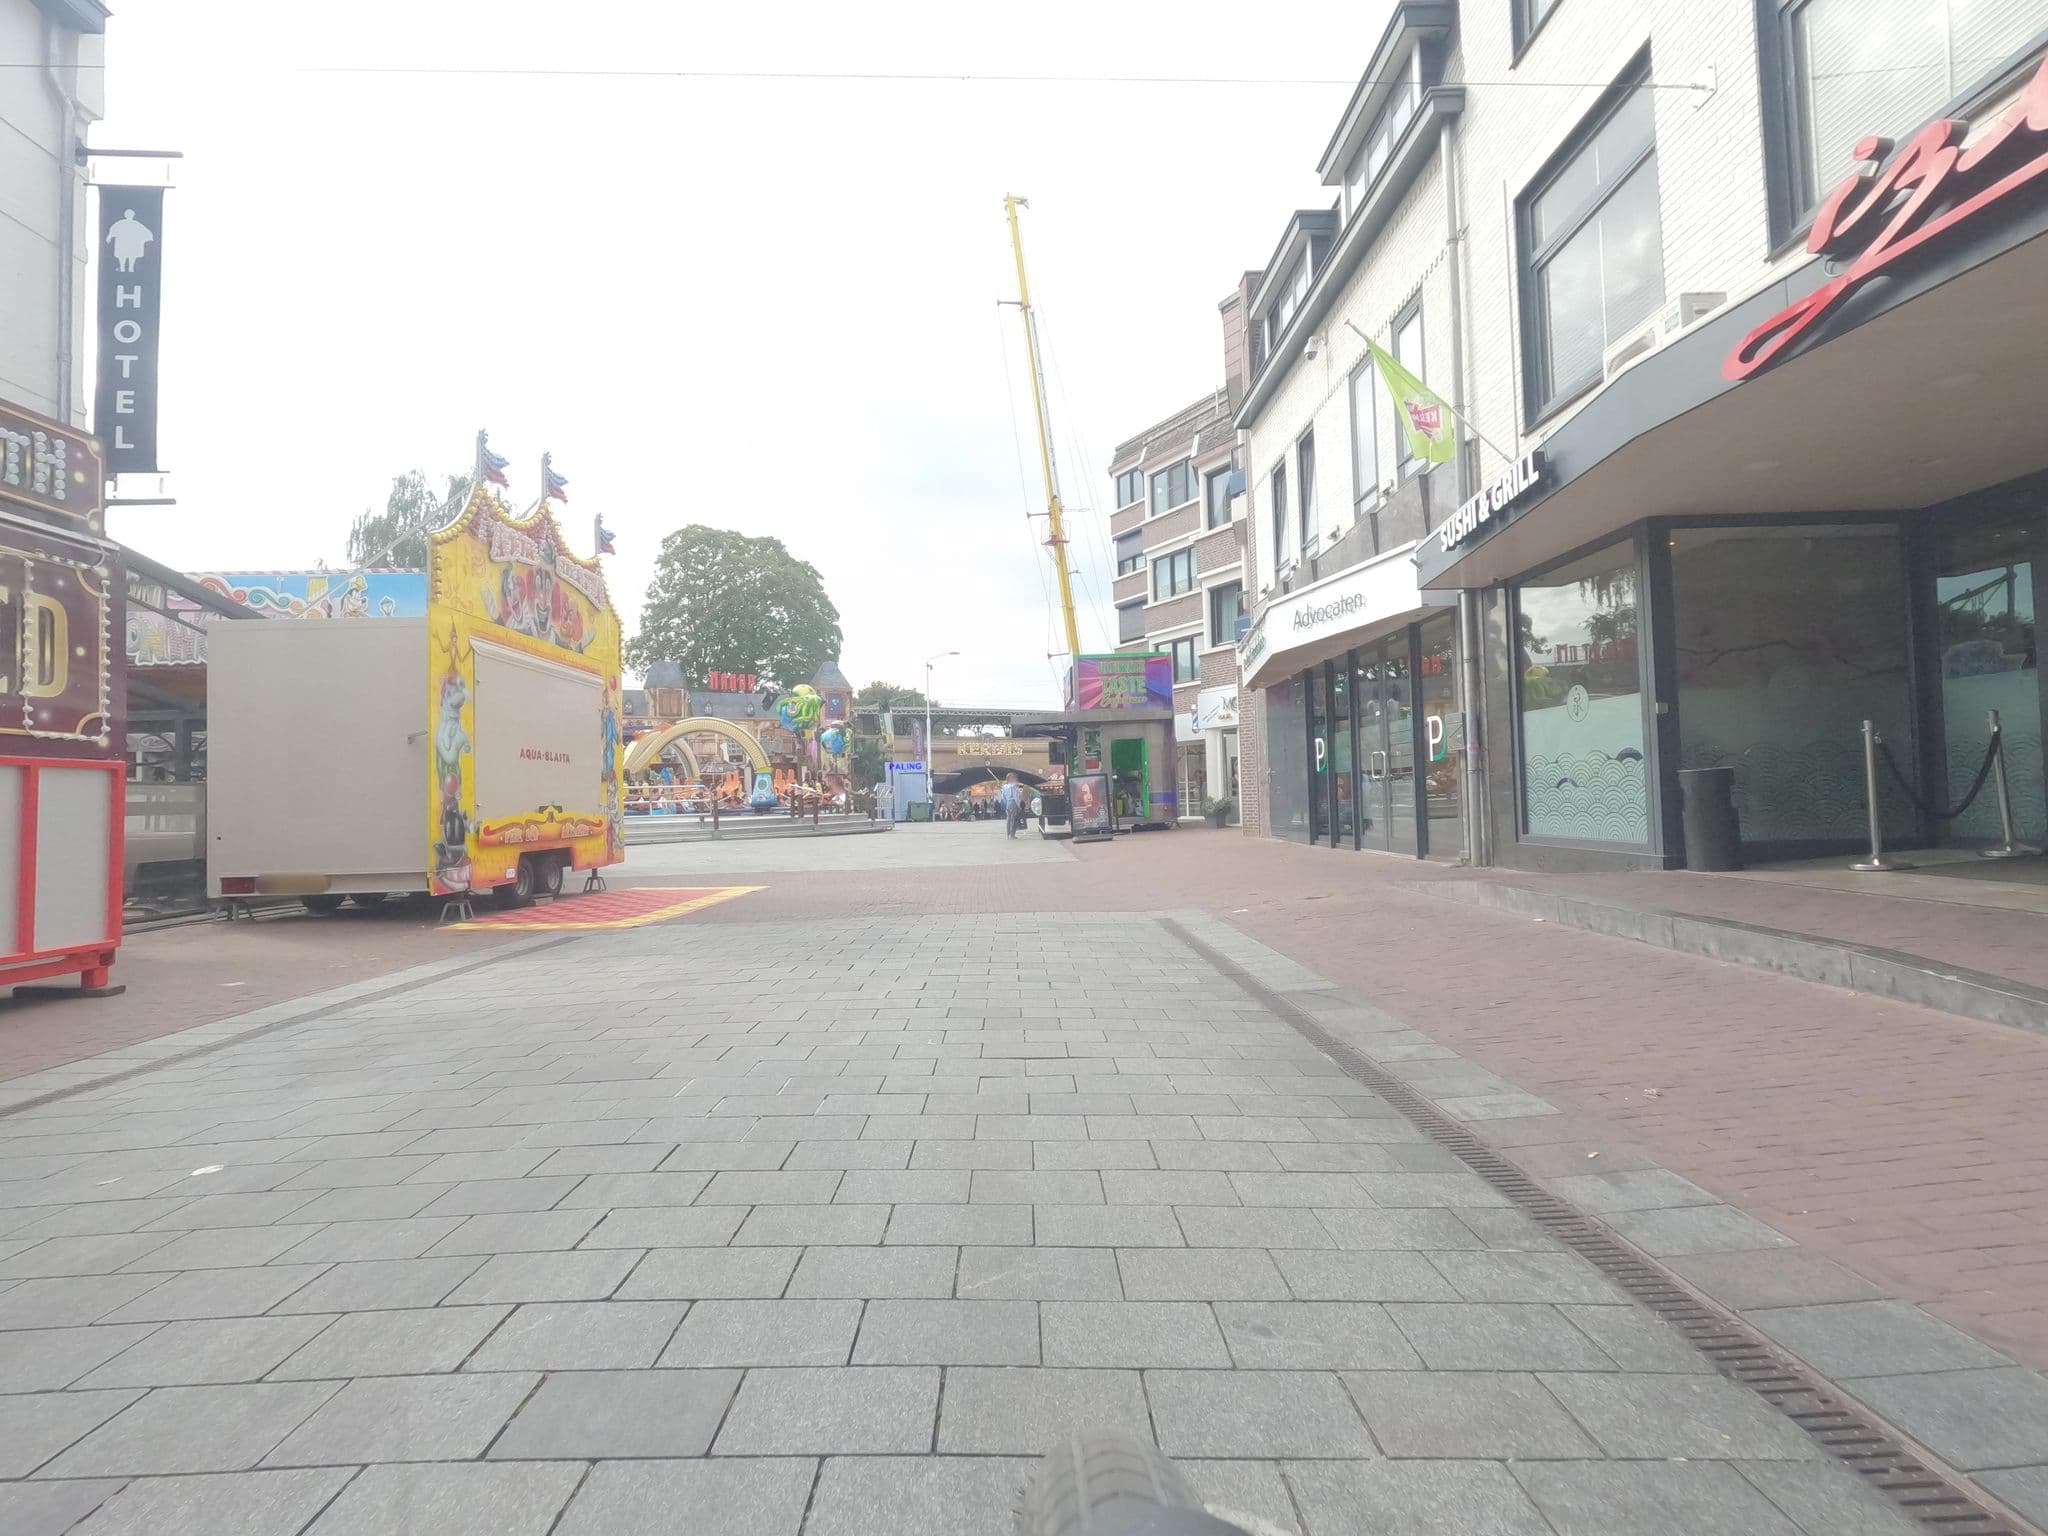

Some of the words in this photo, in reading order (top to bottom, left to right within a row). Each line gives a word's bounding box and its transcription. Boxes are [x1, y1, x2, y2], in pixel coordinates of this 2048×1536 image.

[112, 284, 143, 449] HOTEL
[1440, 499, 1479, 553] SUSHI
[1478, 491, 1490, 523] &
[1491, 450, 1540, 513] GRILL
[1293, 592, 1364, 631] Advocaten
[1101, 676, 1147, 694] TASTE
[888, 762, 923, 771] PALING
